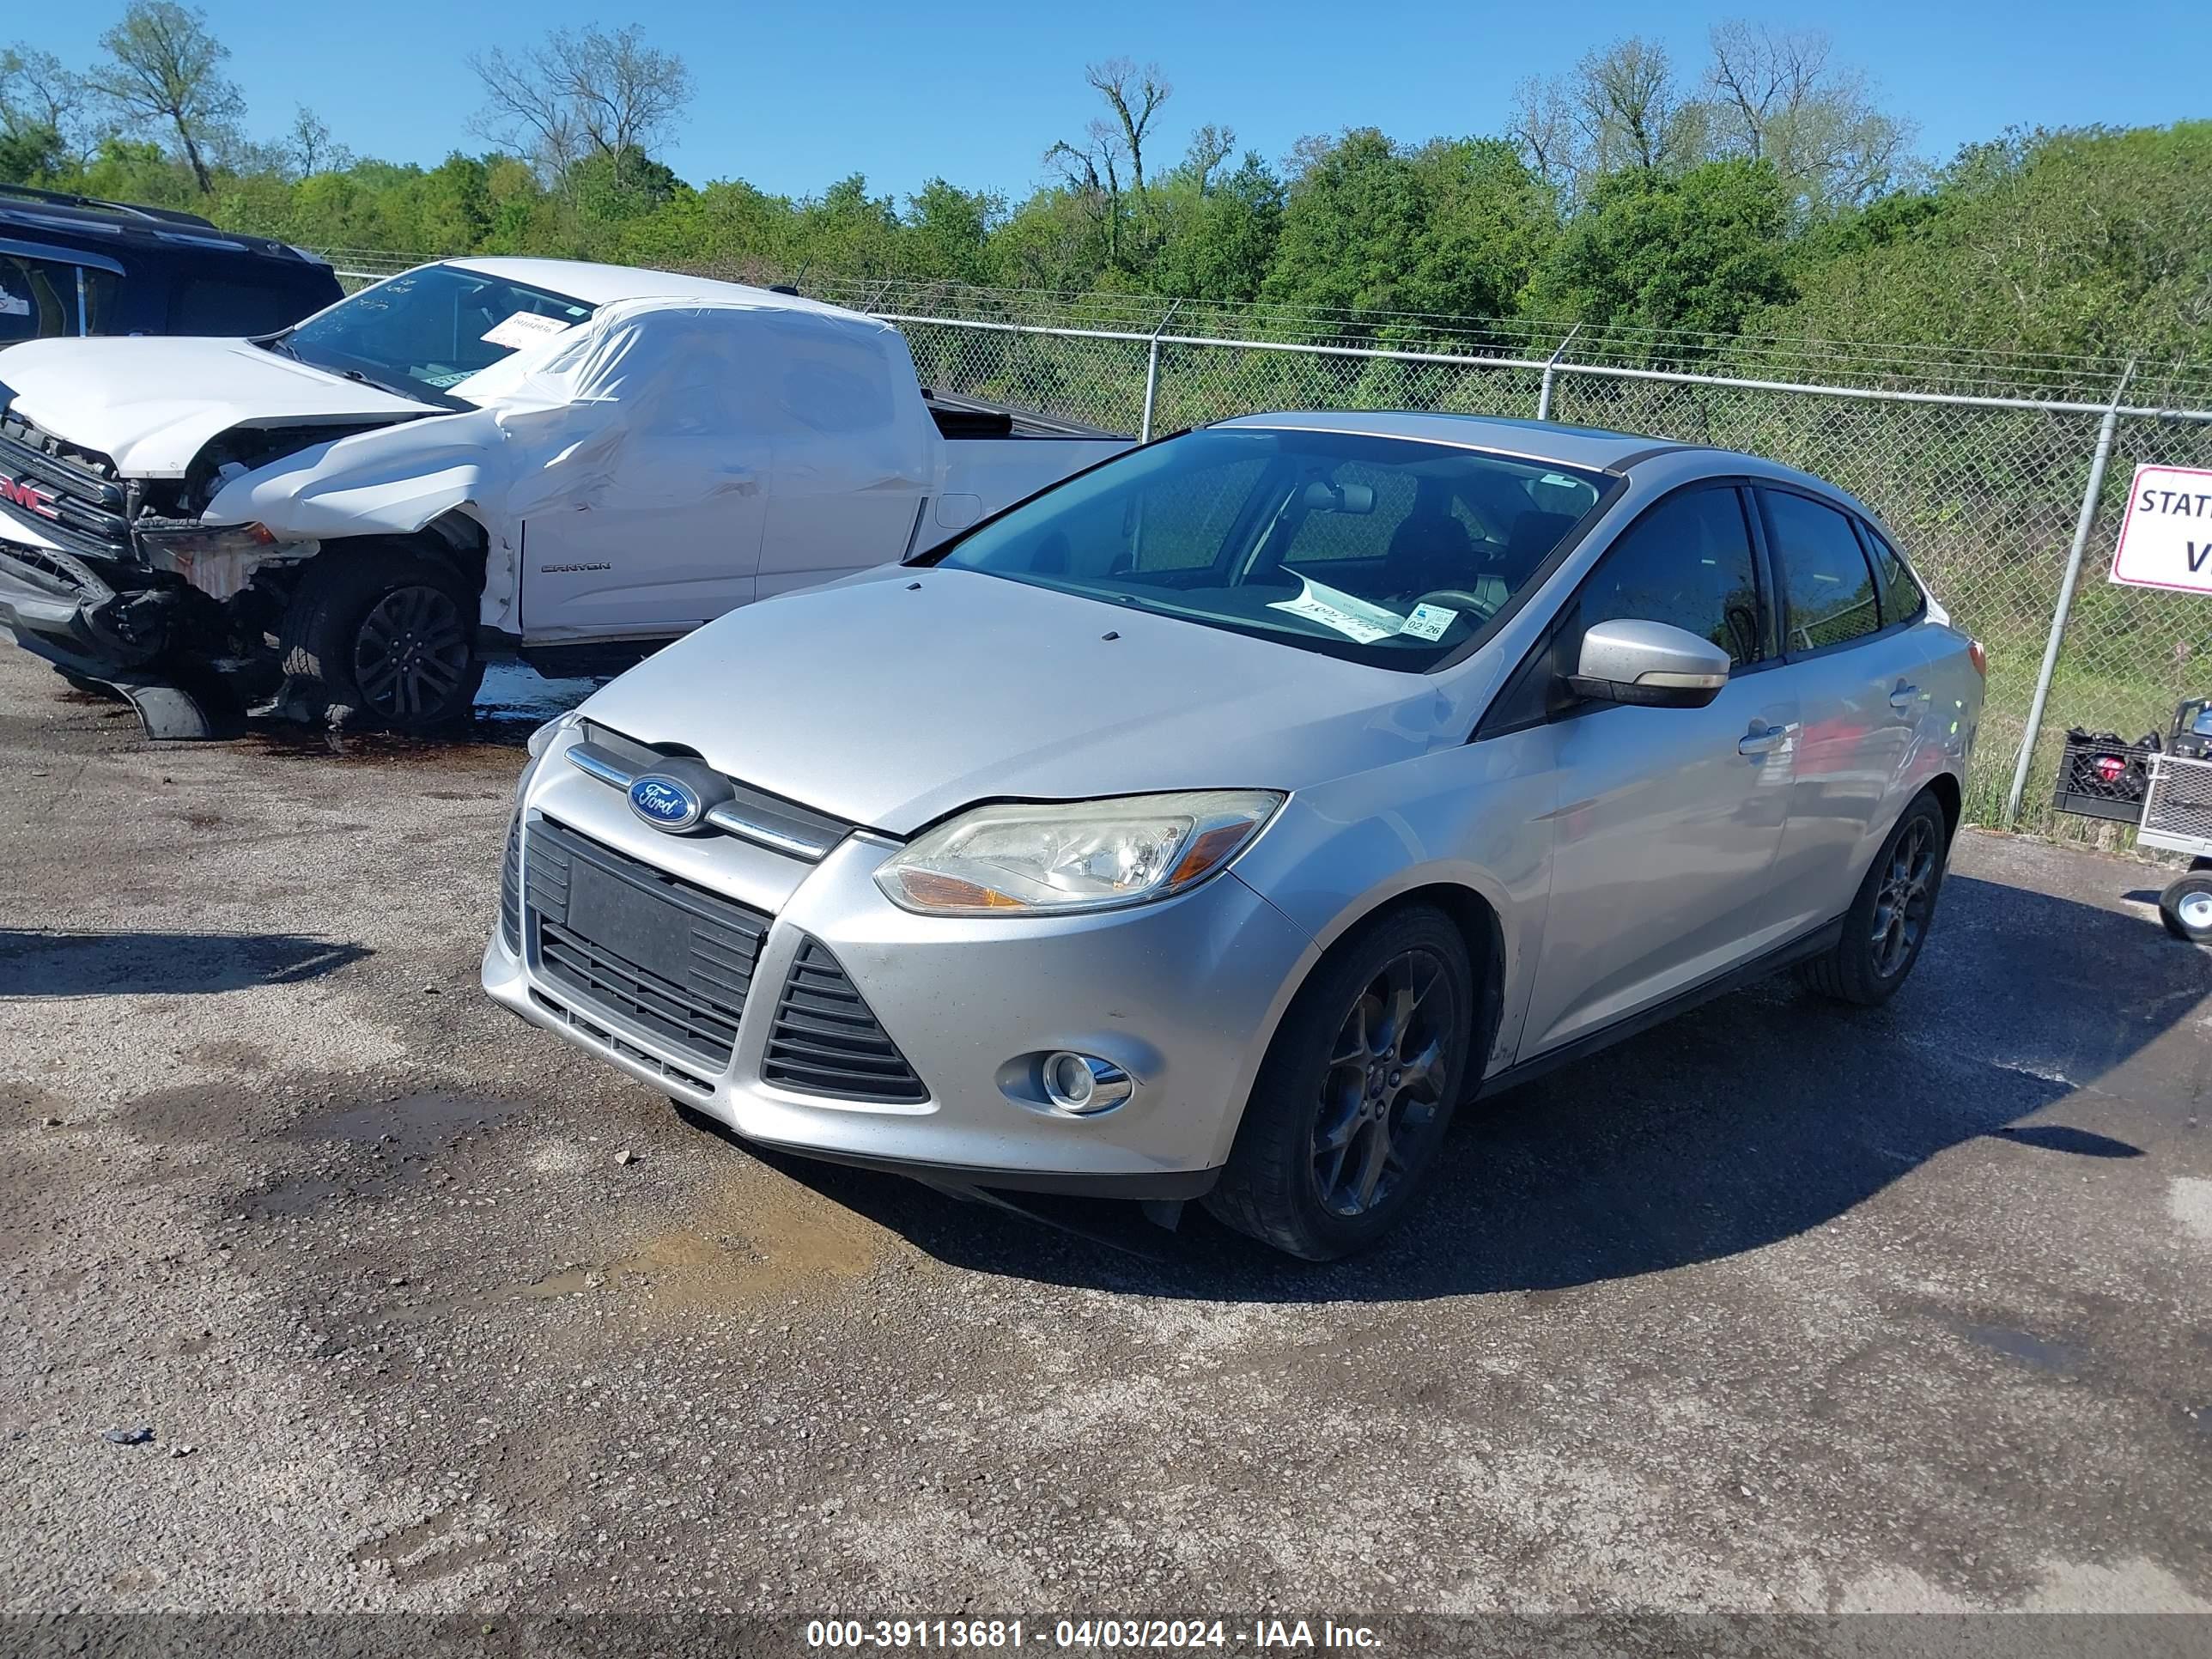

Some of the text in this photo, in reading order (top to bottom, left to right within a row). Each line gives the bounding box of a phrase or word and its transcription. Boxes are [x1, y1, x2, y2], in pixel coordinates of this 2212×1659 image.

[0, 471, 58, 520] MC
[2139, 489, 2212, 519] STAT
[541, 562, 611, 573] CANYON
[2187, 541, 2212, 574] V
[1408, 620, 1441, 635] 02 26
[639, 783, 678, 816] Ford
